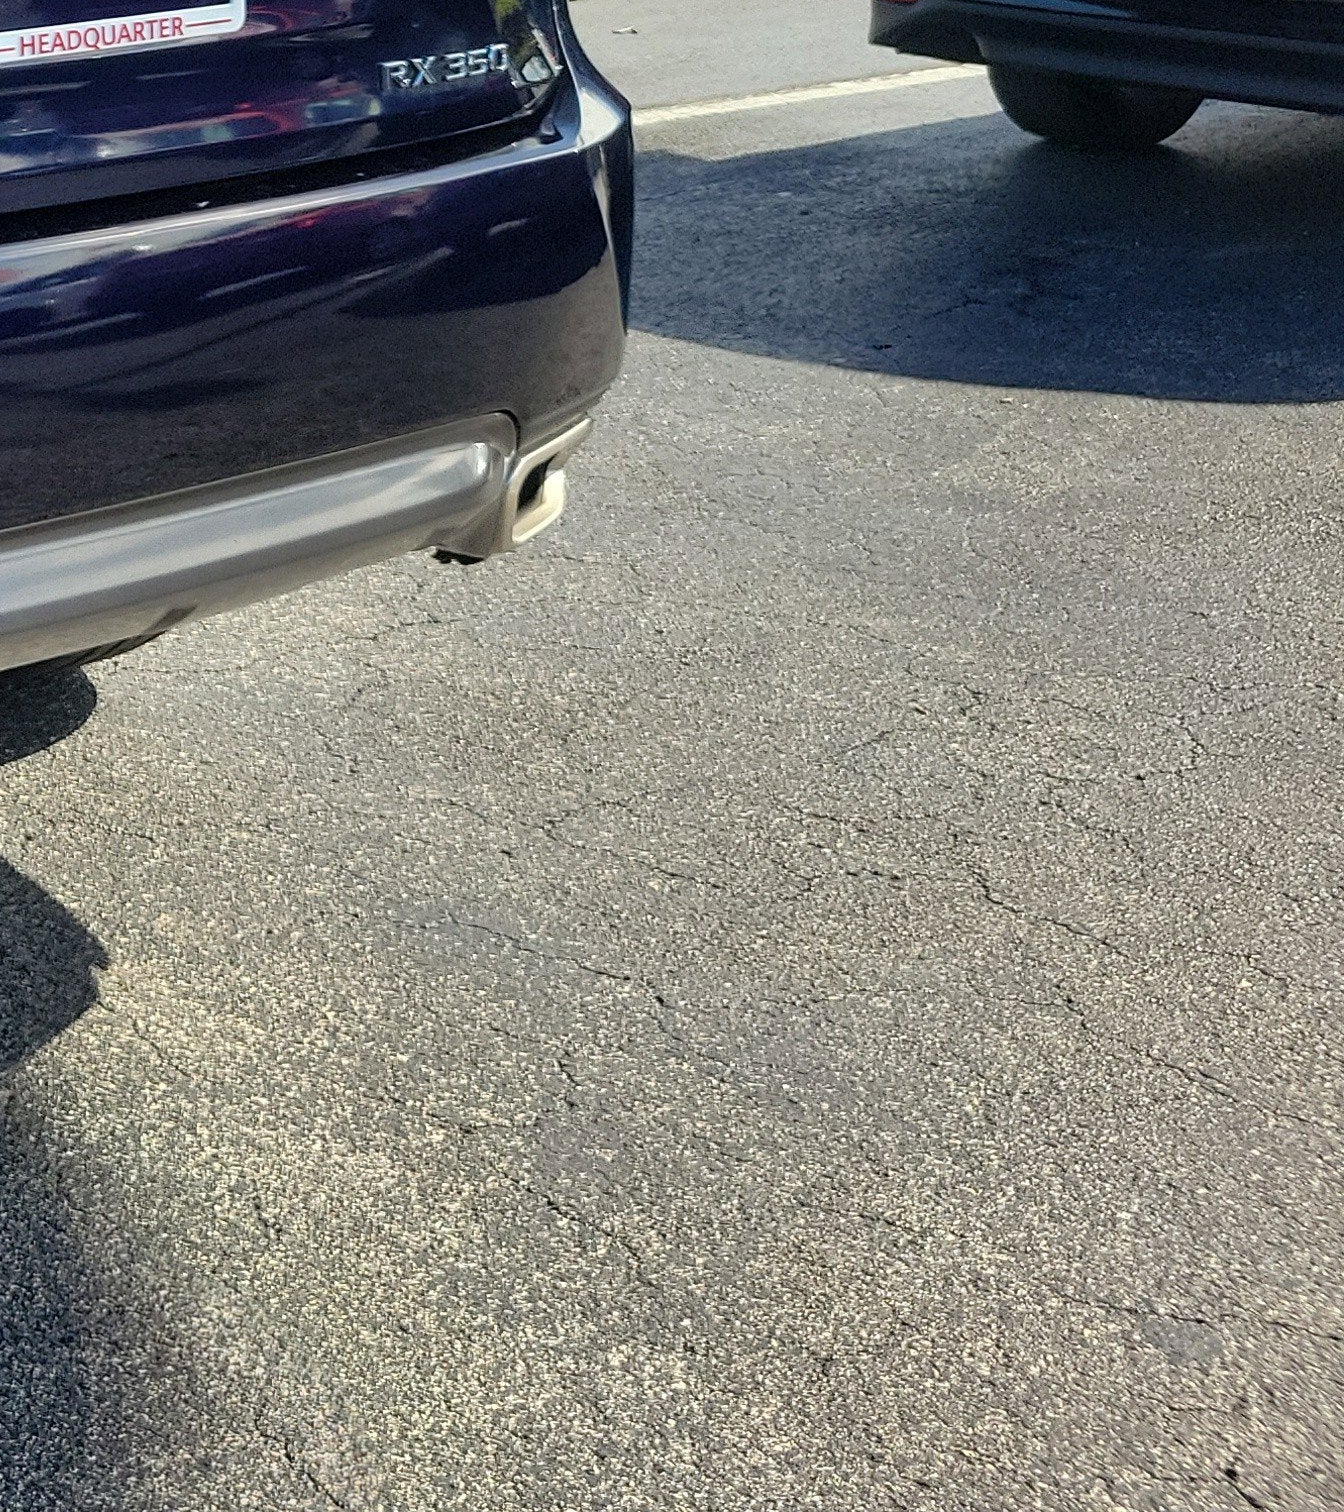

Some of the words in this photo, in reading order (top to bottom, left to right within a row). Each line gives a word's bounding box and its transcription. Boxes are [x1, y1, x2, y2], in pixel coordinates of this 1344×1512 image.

[19, 17, 184, 56] HEADQUARTER
[378, 55, 437, 88] RX
[443, 43, 510, 81] 350
